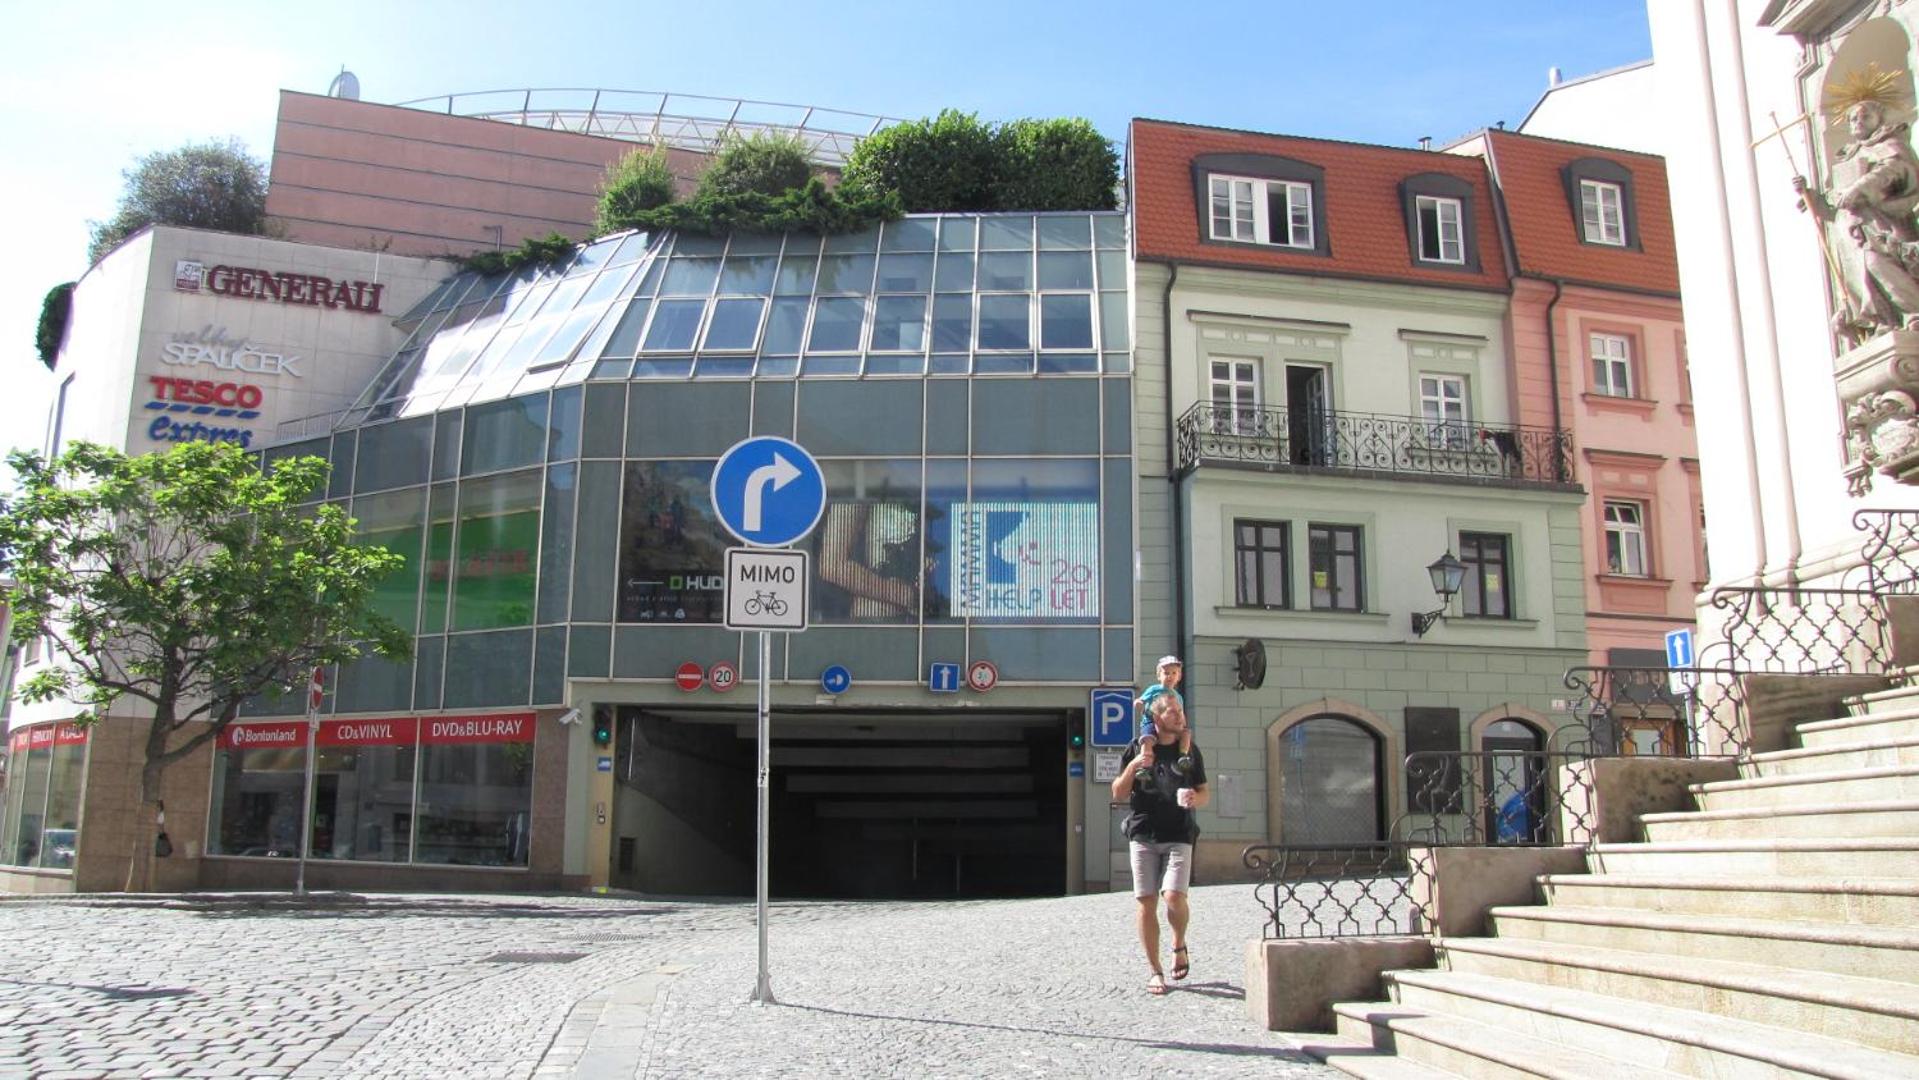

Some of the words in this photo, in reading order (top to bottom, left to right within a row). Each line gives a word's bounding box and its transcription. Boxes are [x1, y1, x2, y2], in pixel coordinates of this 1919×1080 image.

[208, 265, 385, 313] GENERALI
[149, 376, 263, 409] TESCO
[740, 564, 795, 583] MIMO
[1051, 558, 1092, 584] 20
[686, 576, 725, 590] HUD
[1050, 588, 1089, 610] LET
[715, 671, 731, 683] 20
[432, 719, 523, 737] DVD&BLU-RAY
[1101, 702, 1124, 735] P
[245, 728, 297, 742] Bontonland
[337, 723, 393, 740] CD&VINYL
